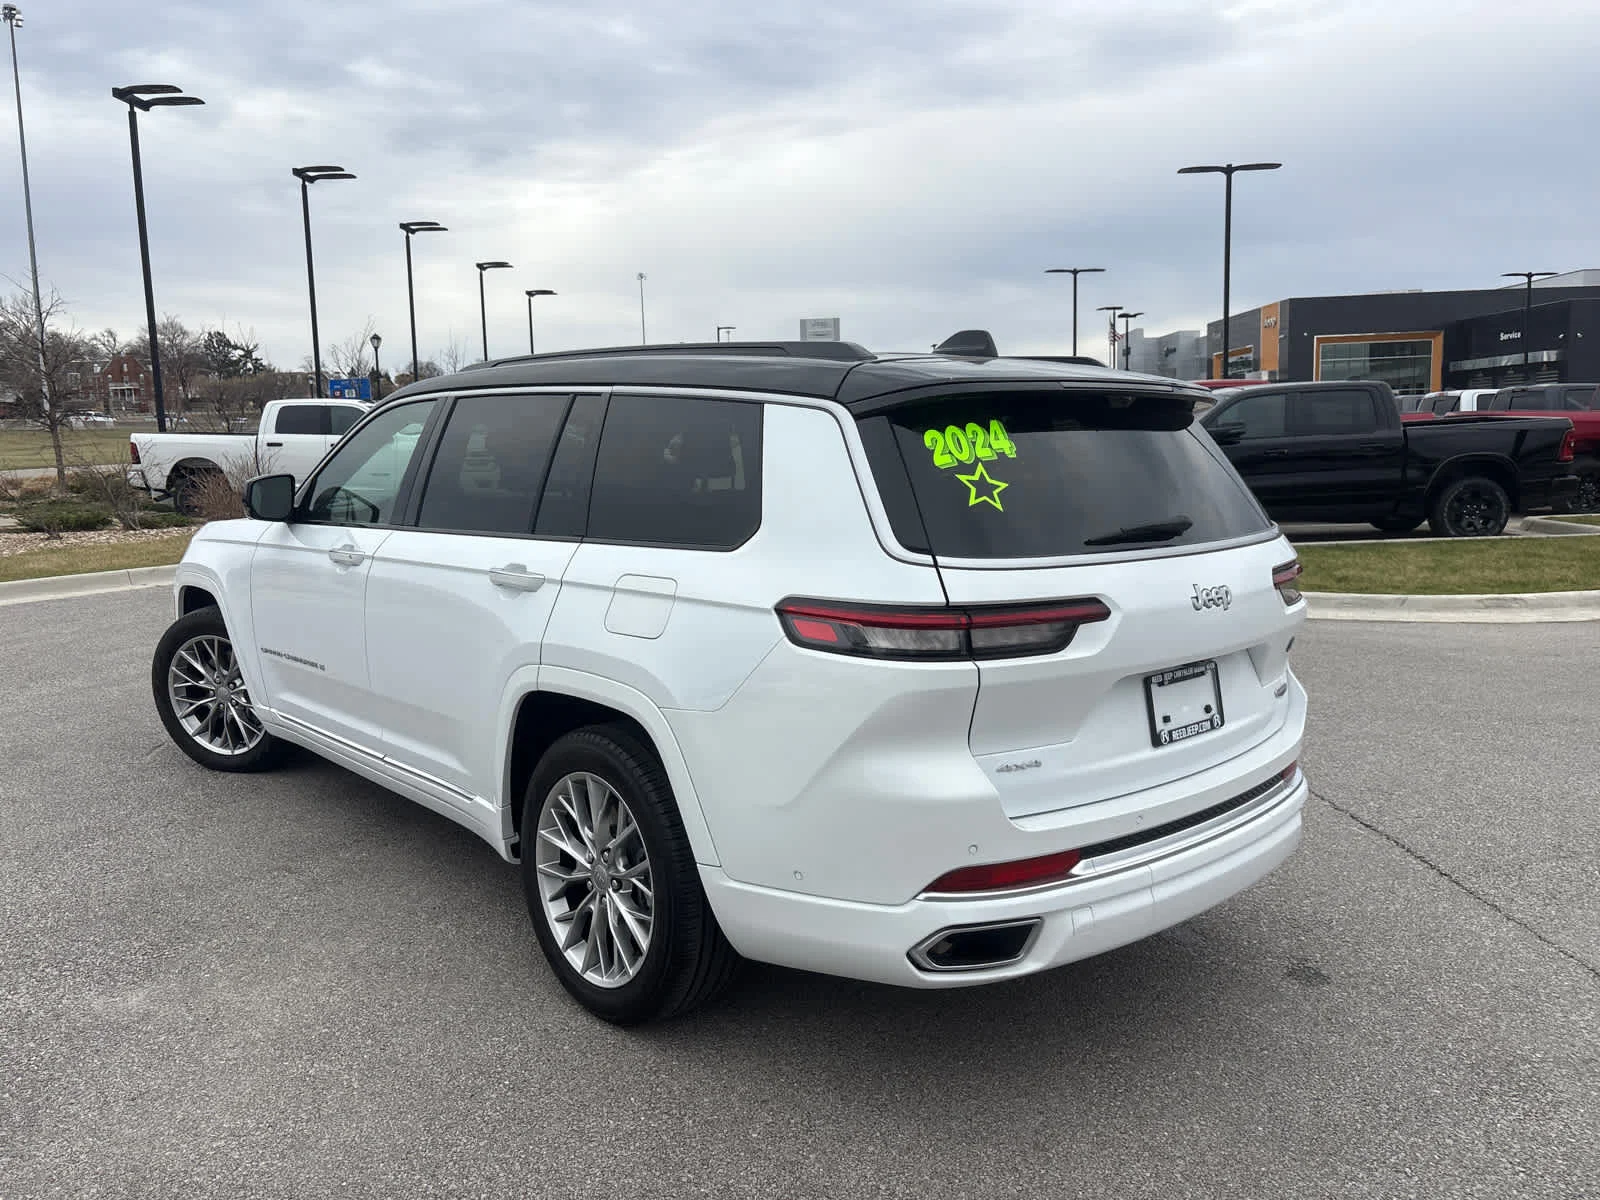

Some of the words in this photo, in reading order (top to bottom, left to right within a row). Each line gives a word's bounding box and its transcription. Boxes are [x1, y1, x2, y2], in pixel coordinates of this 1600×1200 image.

[1500, 331, 1521, 341] Service
[924, 420, 1016, 469] 2024
[1191, 584, 1232, 611] Jeep
[1172, 720, 1211, 741] REEDJEEP.COM
